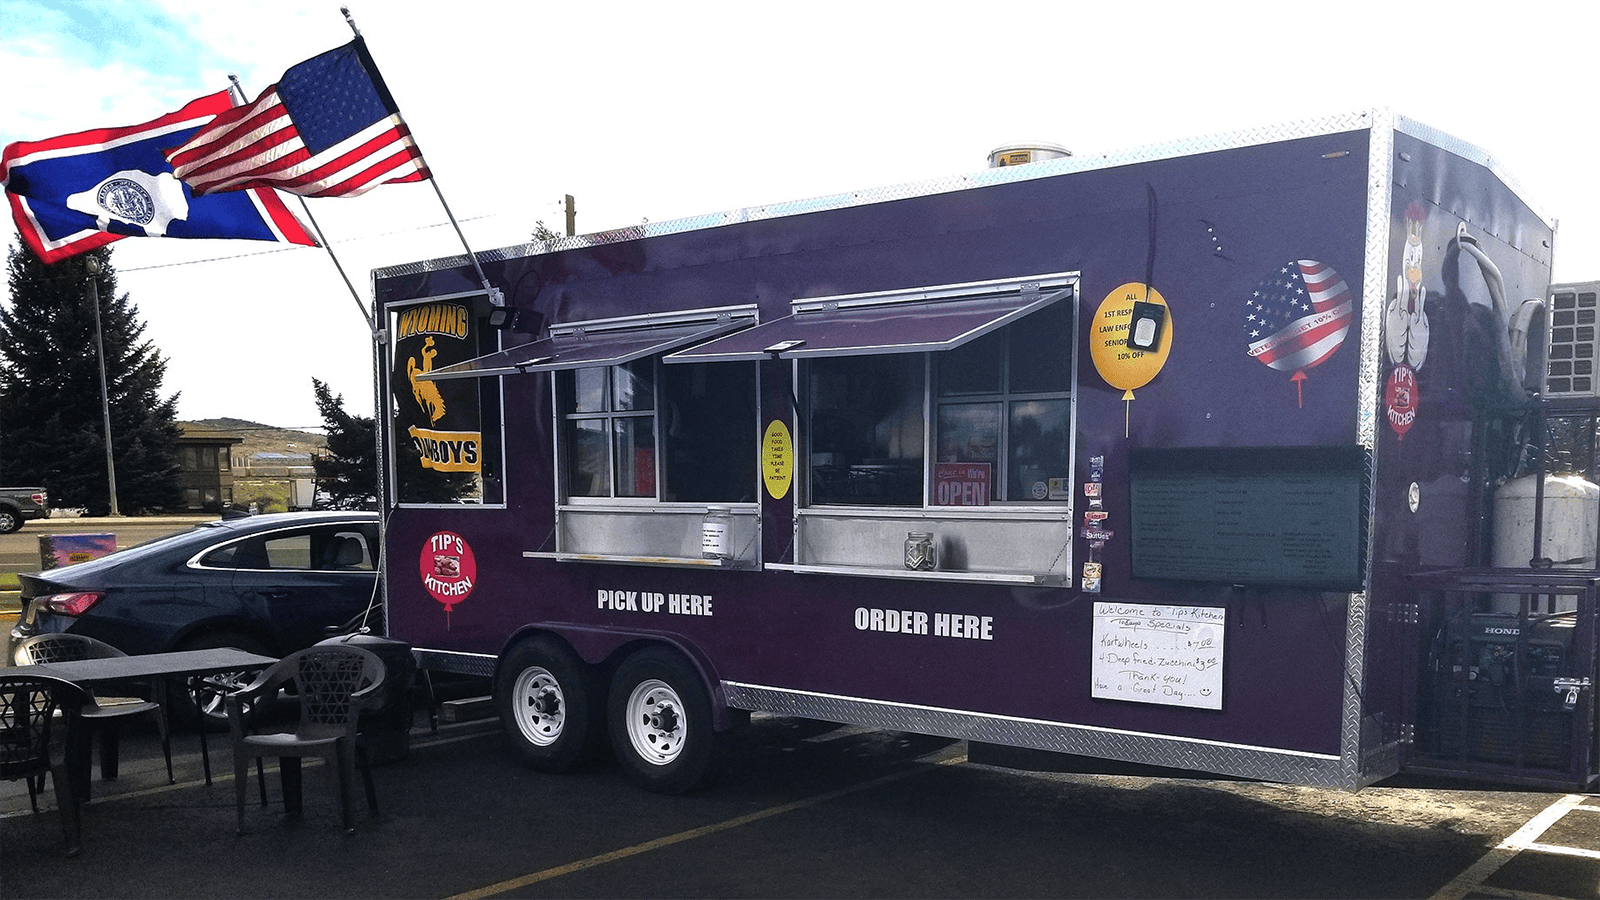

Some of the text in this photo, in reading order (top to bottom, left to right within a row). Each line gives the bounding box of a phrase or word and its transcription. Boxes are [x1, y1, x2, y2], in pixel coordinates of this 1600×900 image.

[397, 303, 468, 341] WYOMING
[1104, 310, 1115, 318] 1ST
[1116, 308, 1133, 317] RESP
[1099, 324, 1114, 333] LAW
[1295, 322, 1312, 336] GET
[1313, 314, 1332, 326] 10%
[1117, 351, 1145, 361] 10% OFF
[1394, 366, 1413, 387] TIP'S
[1387, 404, 1416, 426] KITCHEN
[411, 436, 479, 466] WBOYS
[967, 468, 986, 480] We're
[937, 481, 986, 506] OPEN
[430, 534, 464, 555] TIP'S
[424, 573, 473, 596] KITCHEN
[597, 589, 713, 616] PICK UP HERE
[1099, 604, 1145, 616] Welcome
[1152, 607, 1162, 617] to
[1190, 608, 1224, 620] Kitchen
[854, 607, 994, 641] ORDER HERE
[1147, 619, 1191, 632] Specials
[1484, 627, 1521, 635] HOND
[1100, 633, 1149, 650] Kartwheels
[1094, 677, 1109, 690] Have
[1132, 682, 1157, 694] Great
